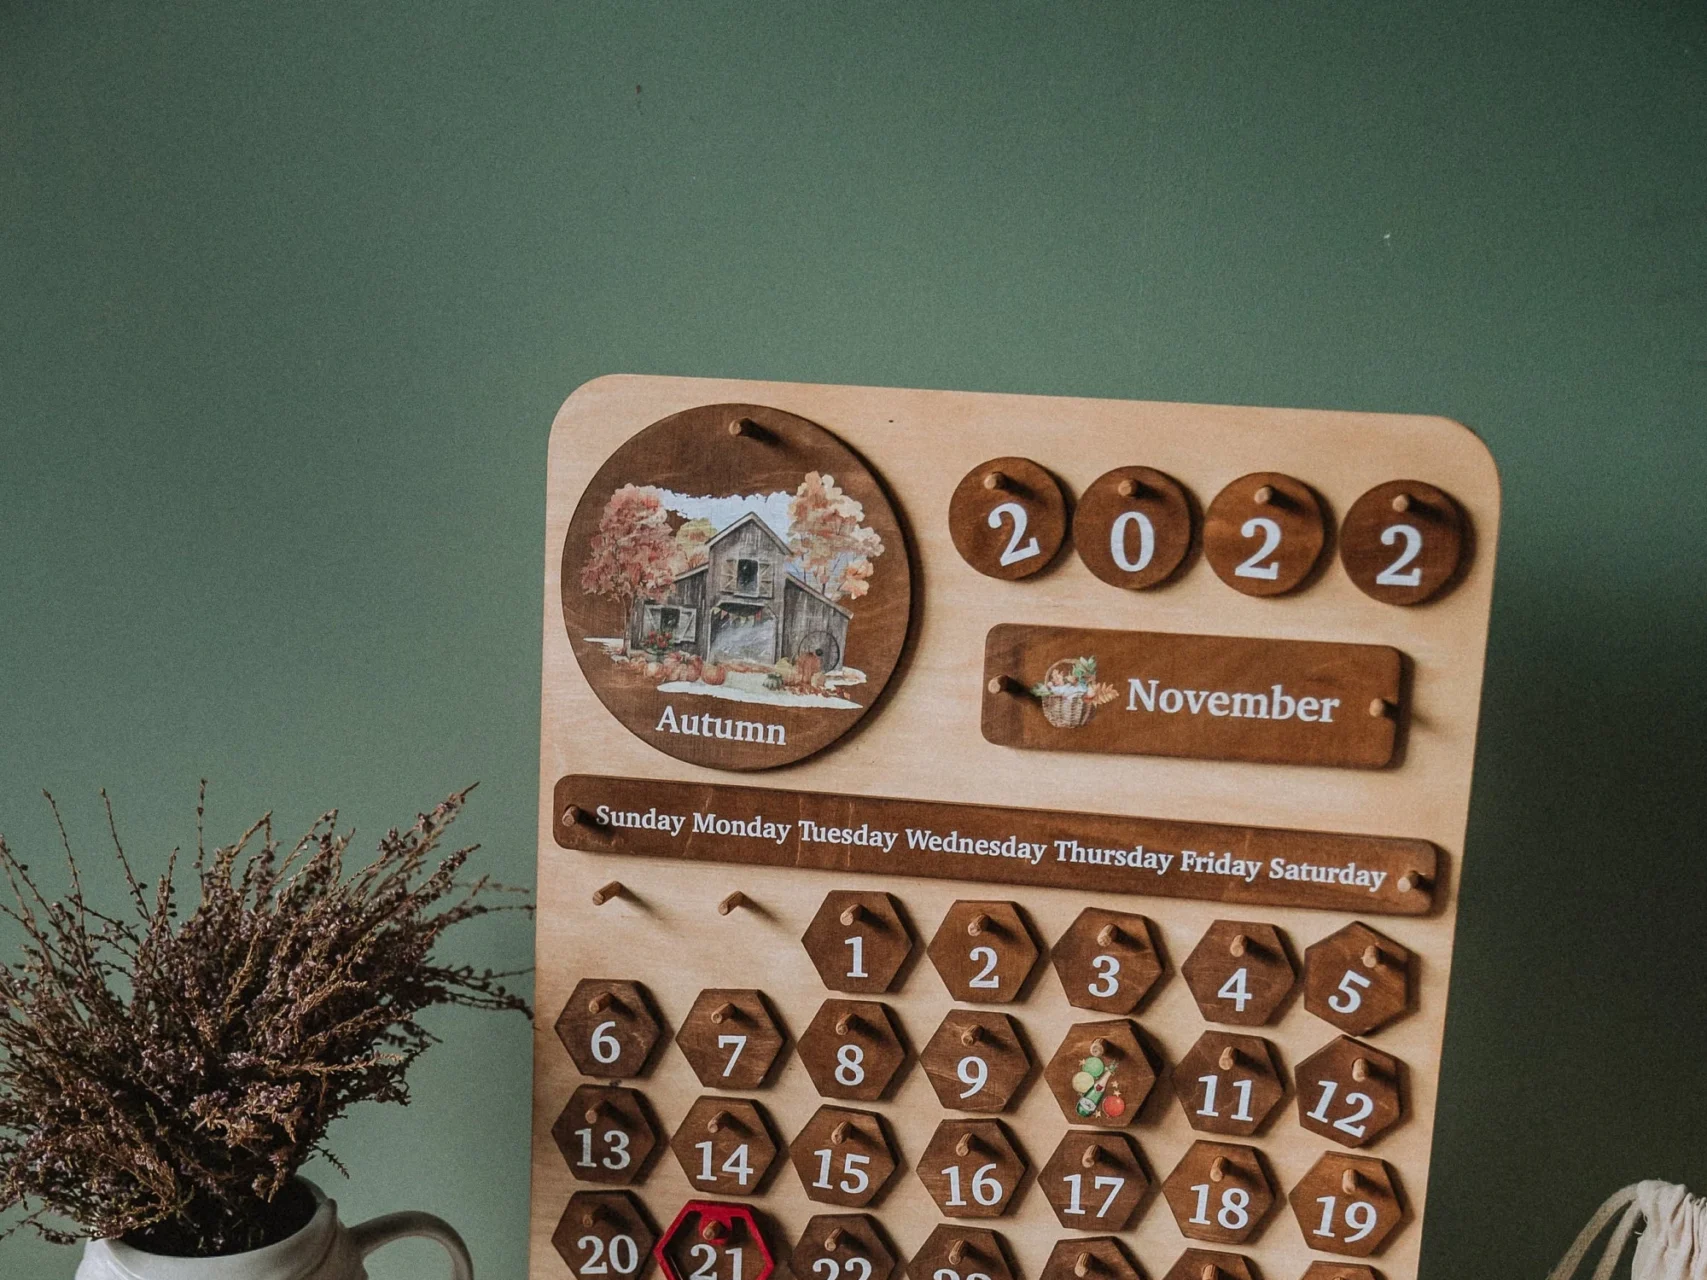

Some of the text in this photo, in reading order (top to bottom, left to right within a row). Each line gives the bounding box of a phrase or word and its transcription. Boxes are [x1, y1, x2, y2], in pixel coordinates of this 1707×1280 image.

[988, 503, 1422, 586] 2 0 2 2
[655, 706, 786, 745] Autumn
[1126, 678, 1340, 722] November
[597, 805, 1387, 892] Sunday Monday Tuesday Wednesday Thursday Friday Saturday
[845, 937, 1370, 1013] 1 2 3 4 5
[591, 1021, 1373, 1139] 6 7 8 9 11 12
[575, 1128, 1377, 1242] 13 14 15 16 17 18 19
[578, 1235, 638, 1274] 20
